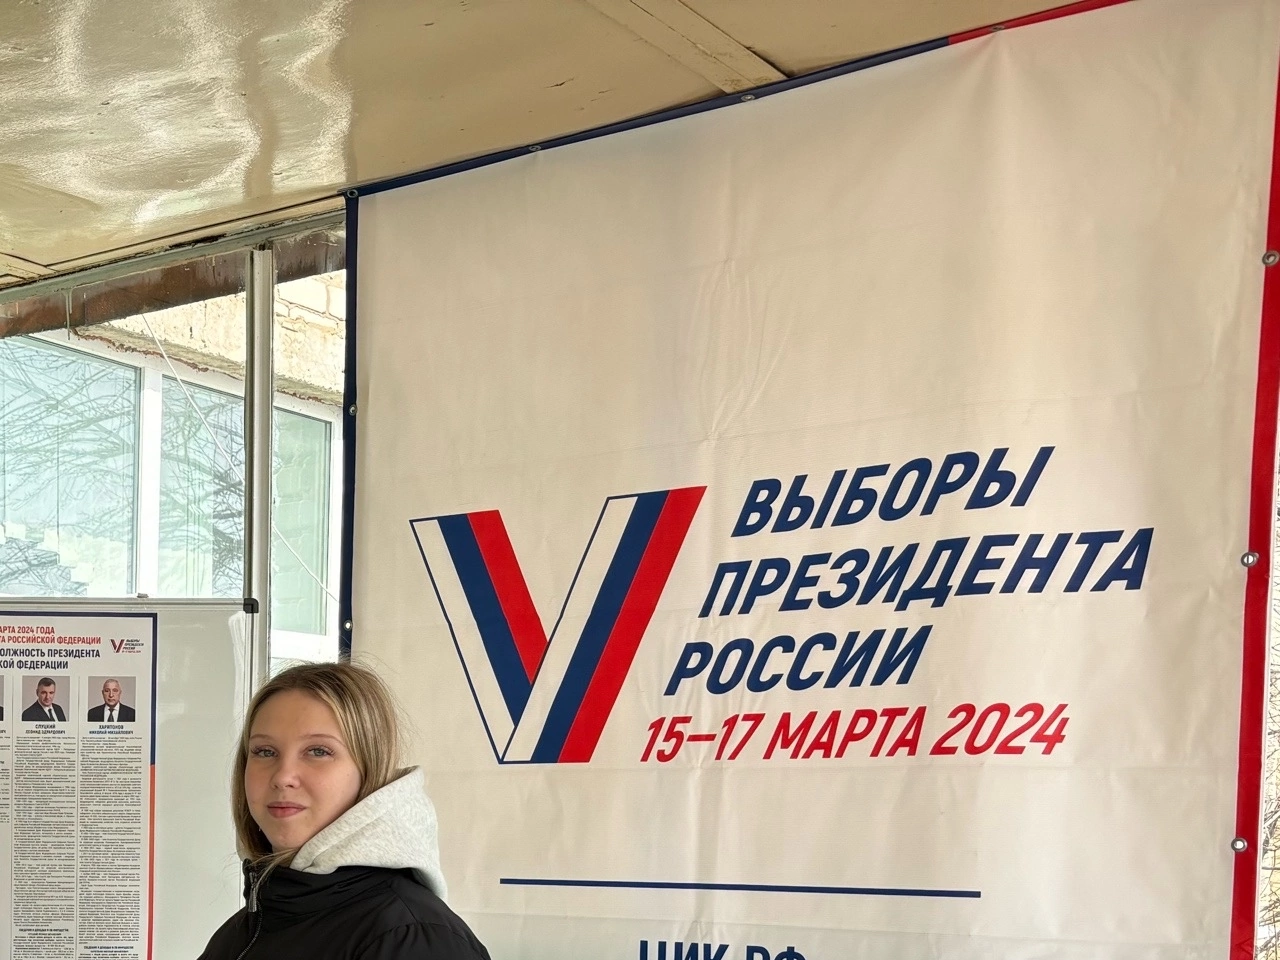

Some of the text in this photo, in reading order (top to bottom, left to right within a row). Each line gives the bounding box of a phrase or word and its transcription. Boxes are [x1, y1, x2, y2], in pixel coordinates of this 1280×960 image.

[731, 447, 1055, 537] ВЫБОРЫ
[698, 528, 1153, 617] ПРЕЗИДЕНТА
[7, 633, 55, 644] РОССИЙСКОЙ
[57, 635, 101, 645] ФЕДЕРАЦИИ
[17, 626, 34, 634] 2024
[36, 626, 55, 634] ГОДА
[17, 660, 68, 670] ФЕДЕРАЦИИ
[47, 648, 100, 658] ПРЕЗИДЕНТА
[664, 625, 933, 696] РОССИИ
[640, 703, 1068, 762] 15–17 МАРТА 2024
